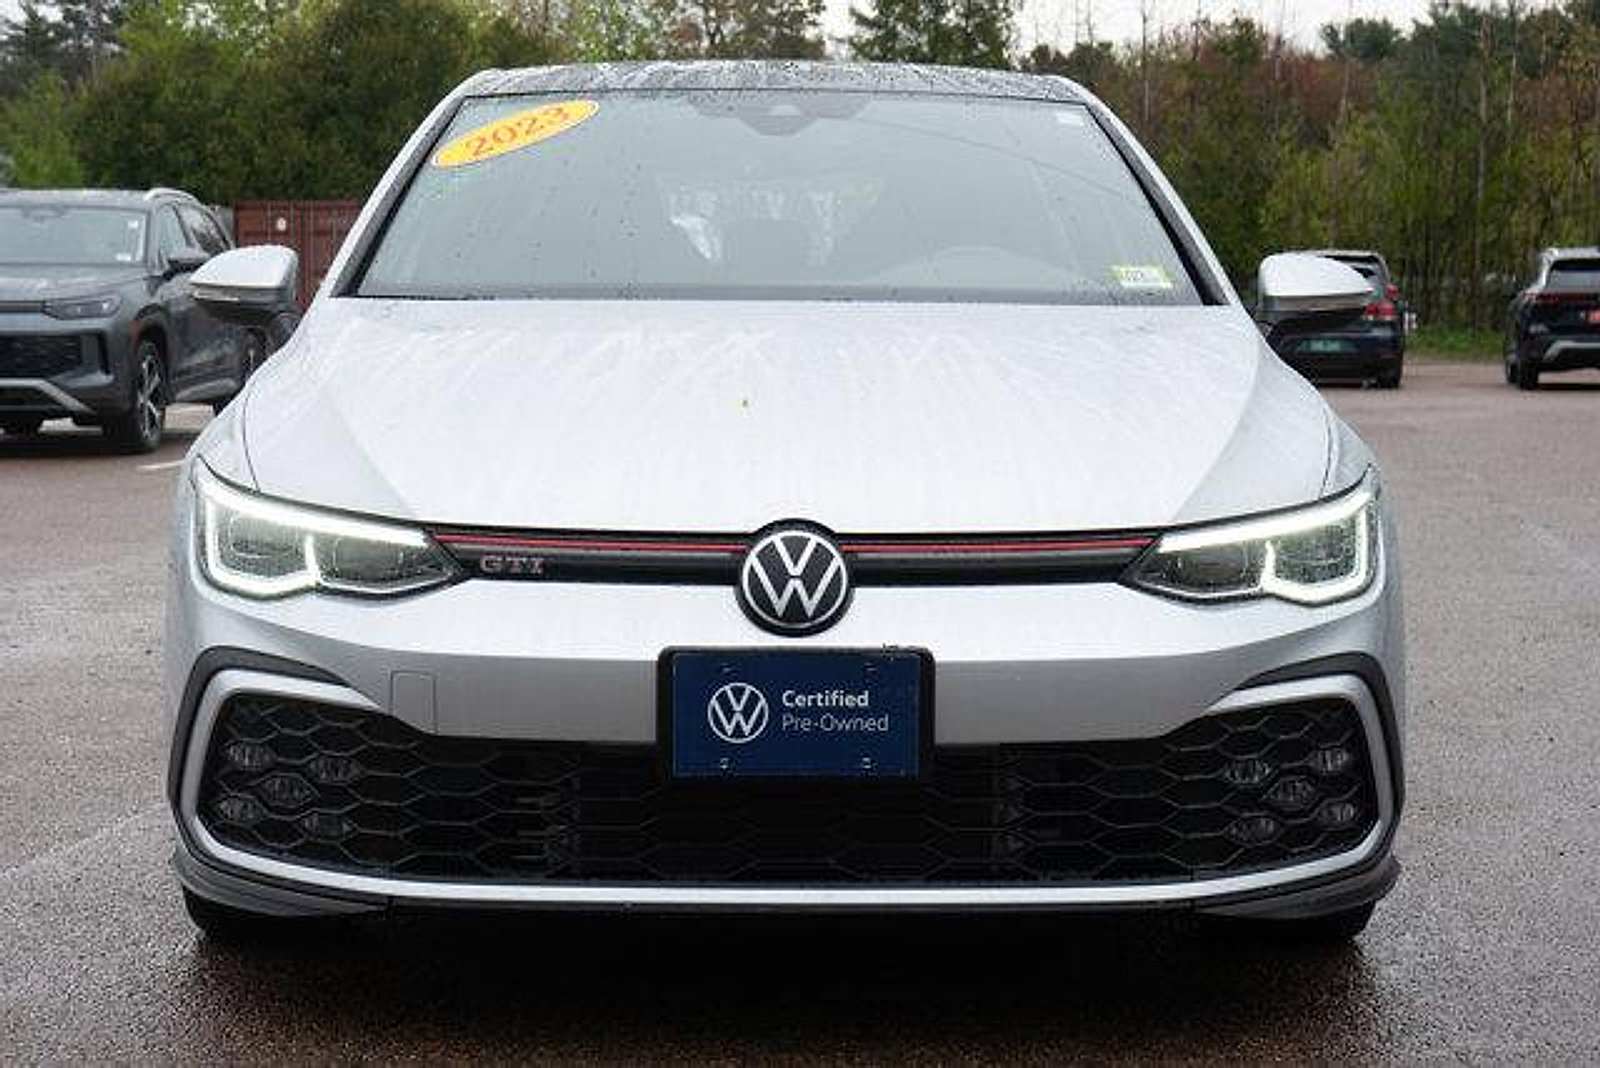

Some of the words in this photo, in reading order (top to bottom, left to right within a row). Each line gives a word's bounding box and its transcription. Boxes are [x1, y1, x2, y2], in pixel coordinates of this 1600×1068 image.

[465, 106, 570, 156] 2023
[480, 555, 544, 574] GTI
[746, 531, 844, 623] VW
[782, 690, 870, 707] Certified
[782, 713, 890, 732] Pre-Owned
